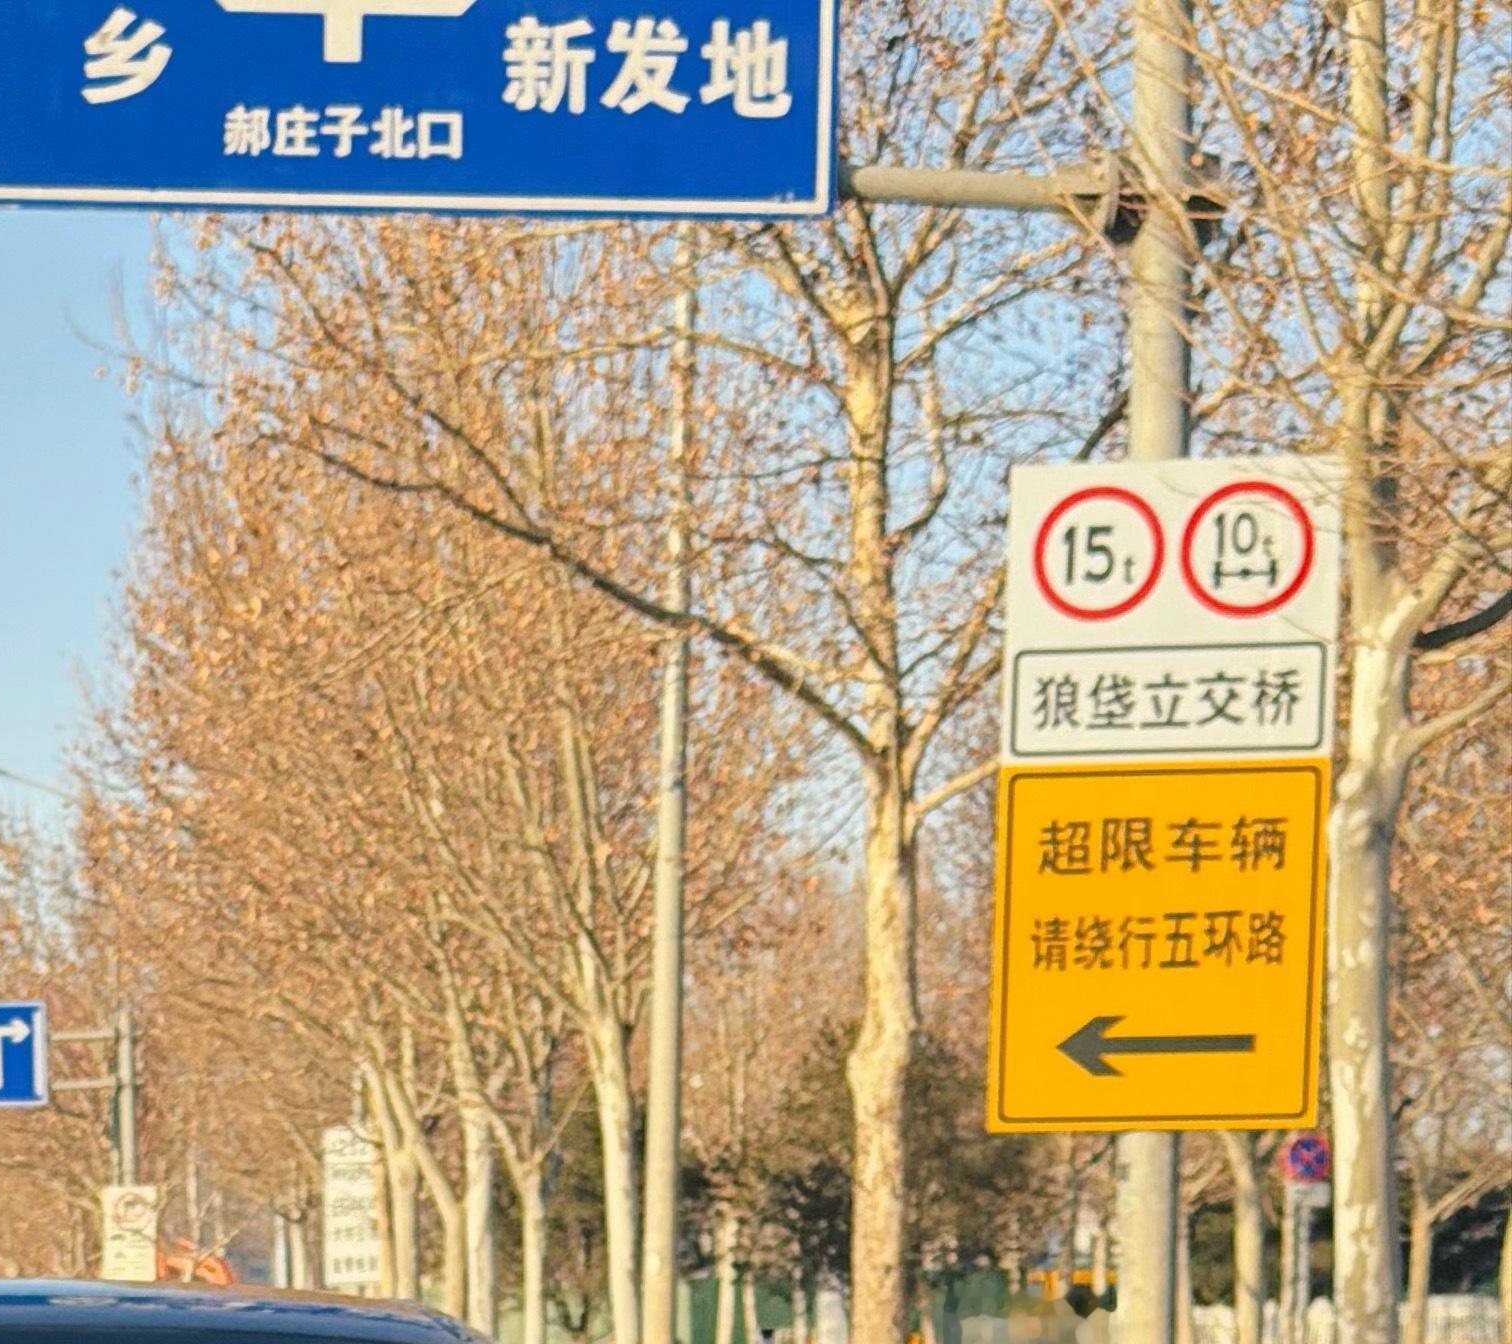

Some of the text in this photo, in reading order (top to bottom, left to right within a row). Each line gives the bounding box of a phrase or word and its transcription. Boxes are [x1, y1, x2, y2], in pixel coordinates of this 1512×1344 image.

[501, 15, 792, 118] 新发地
[222, 103, 464, 159] 郝庄子北口
[1033, 669, 1301, 730] 狼垡立交桥
[1038, 816, 1288, 875] 超限车辆
[1030, 910, 1287, 971] 请绕行五环路
